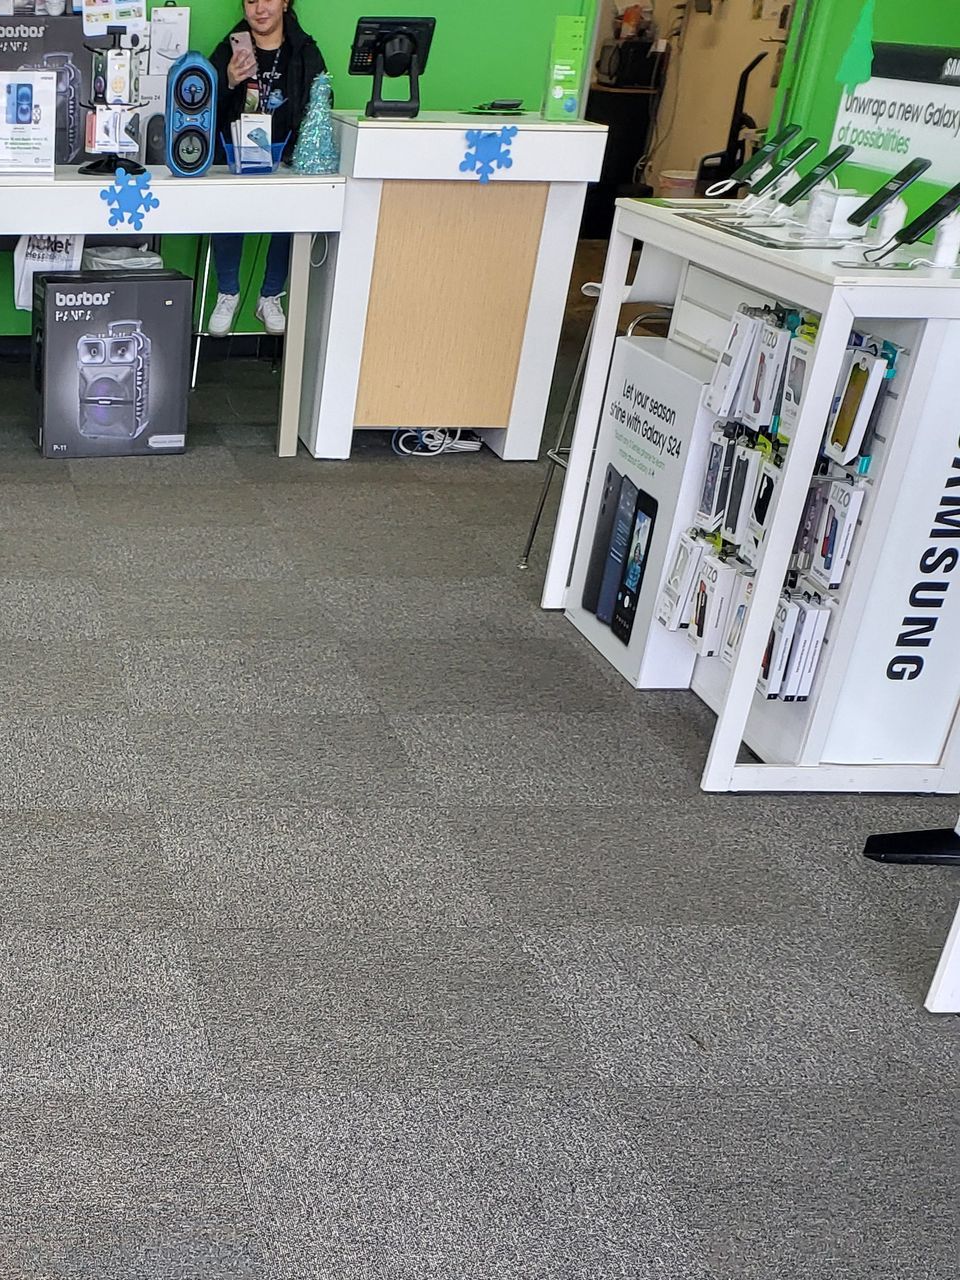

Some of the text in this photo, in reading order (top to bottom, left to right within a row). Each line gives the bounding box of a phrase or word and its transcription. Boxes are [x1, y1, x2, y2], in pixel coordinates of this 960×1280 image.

[887, 100, 897, 119] a
[896, 101, 924, 123] new
[924, 102, 960, 138] Galaxy
[837, 121, 911, 154] of possibilities
[55, 291, 110, 306] bosbos
[622, 379, 676, 427] Let your season
[610, 401, 626, 425] shine
[626, 412, 641, 435] with
[641, 420, 668, 456] Galaxy
[666, 435, 682, 459] S24
[831, 484, 851, 508] ZIZO
[702, 561, 718, 583] ZIZO
[886, 434, 960, 681] MSUNG
